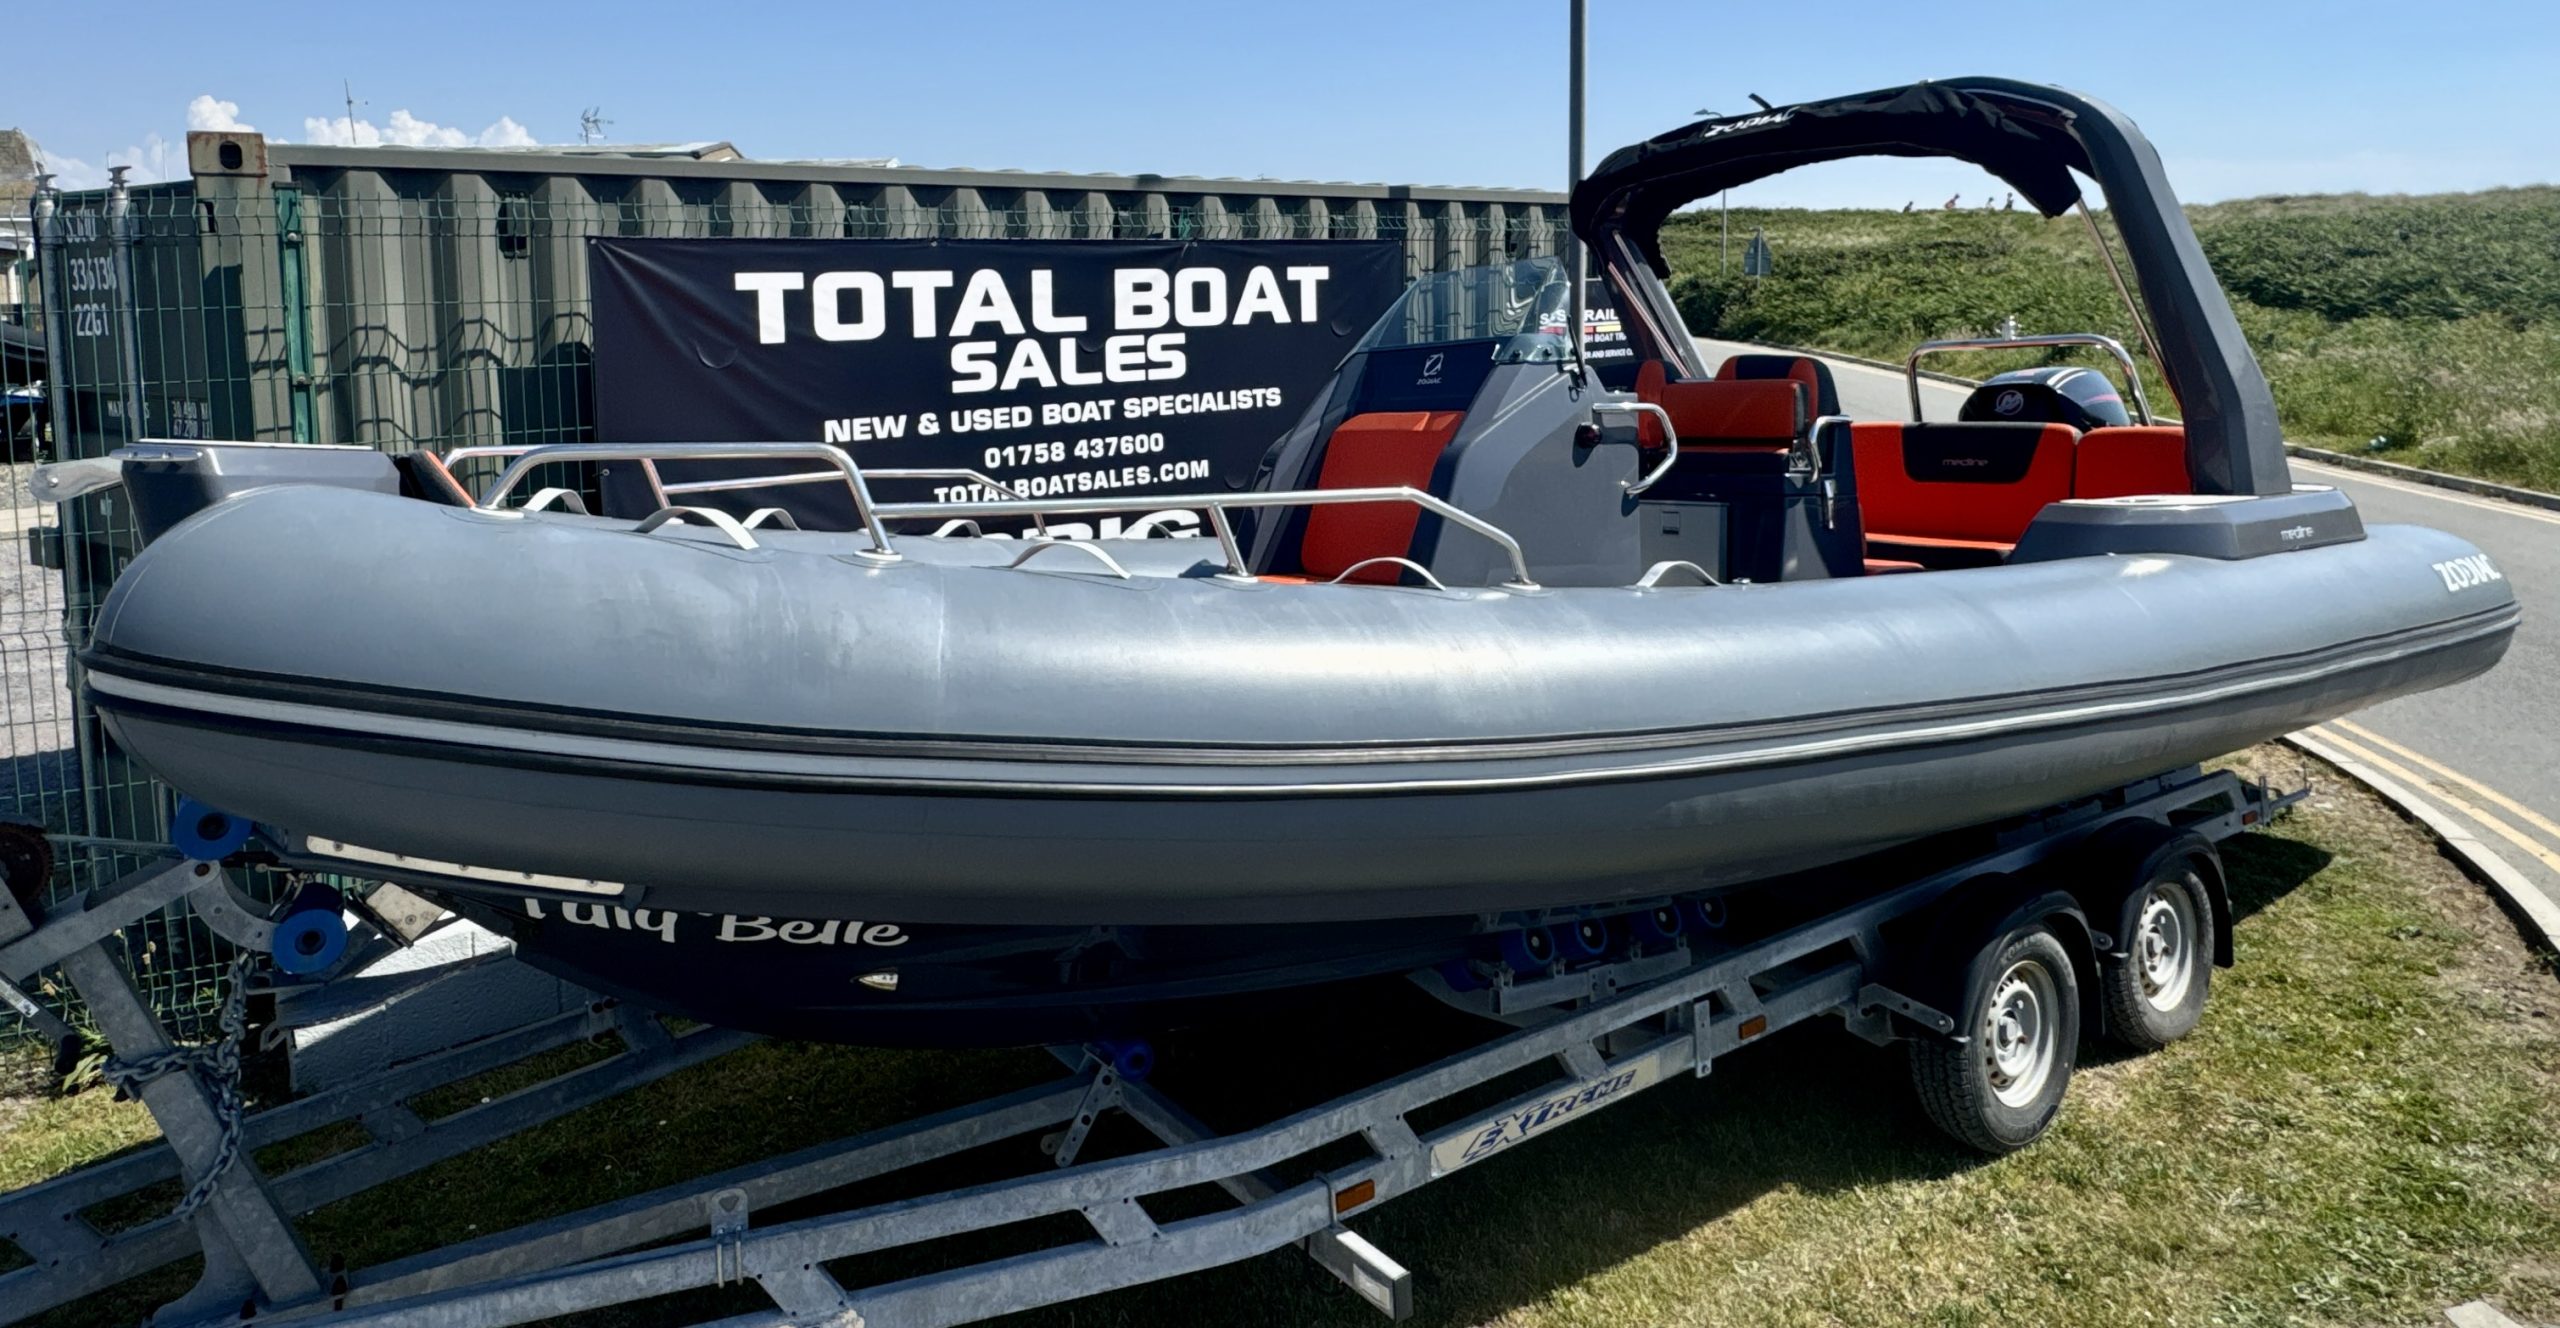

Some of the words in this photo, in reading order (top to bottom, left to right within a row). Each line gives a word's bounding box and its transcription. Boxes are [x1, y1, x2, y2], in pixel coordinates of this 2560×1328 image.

[1704, 106, 1800, 137] ZODIAC
[74, 302, 109, 336] 22G1
[734, 269, 1088, 345] TOTAL
[1114, 265, 1330, 330] BOAT
[950, 332, 1187, 394] SALES
[824, 414, 908, 444] NEW
[917, 412, 941, 436] &
[950, 405, 1033, 433] USED
[1042, 399, 1116, 426] BOAT
[1123, 387, 1282, 419] SPECIALISTS
[984, 442, 1066, 469] 01758
[1073, 432, 1164, 459] 437600
[933, 459, 1210, 503] TOTALBOATSALES.COM
[1462, 1068, 1637, 1163] EXTREME
